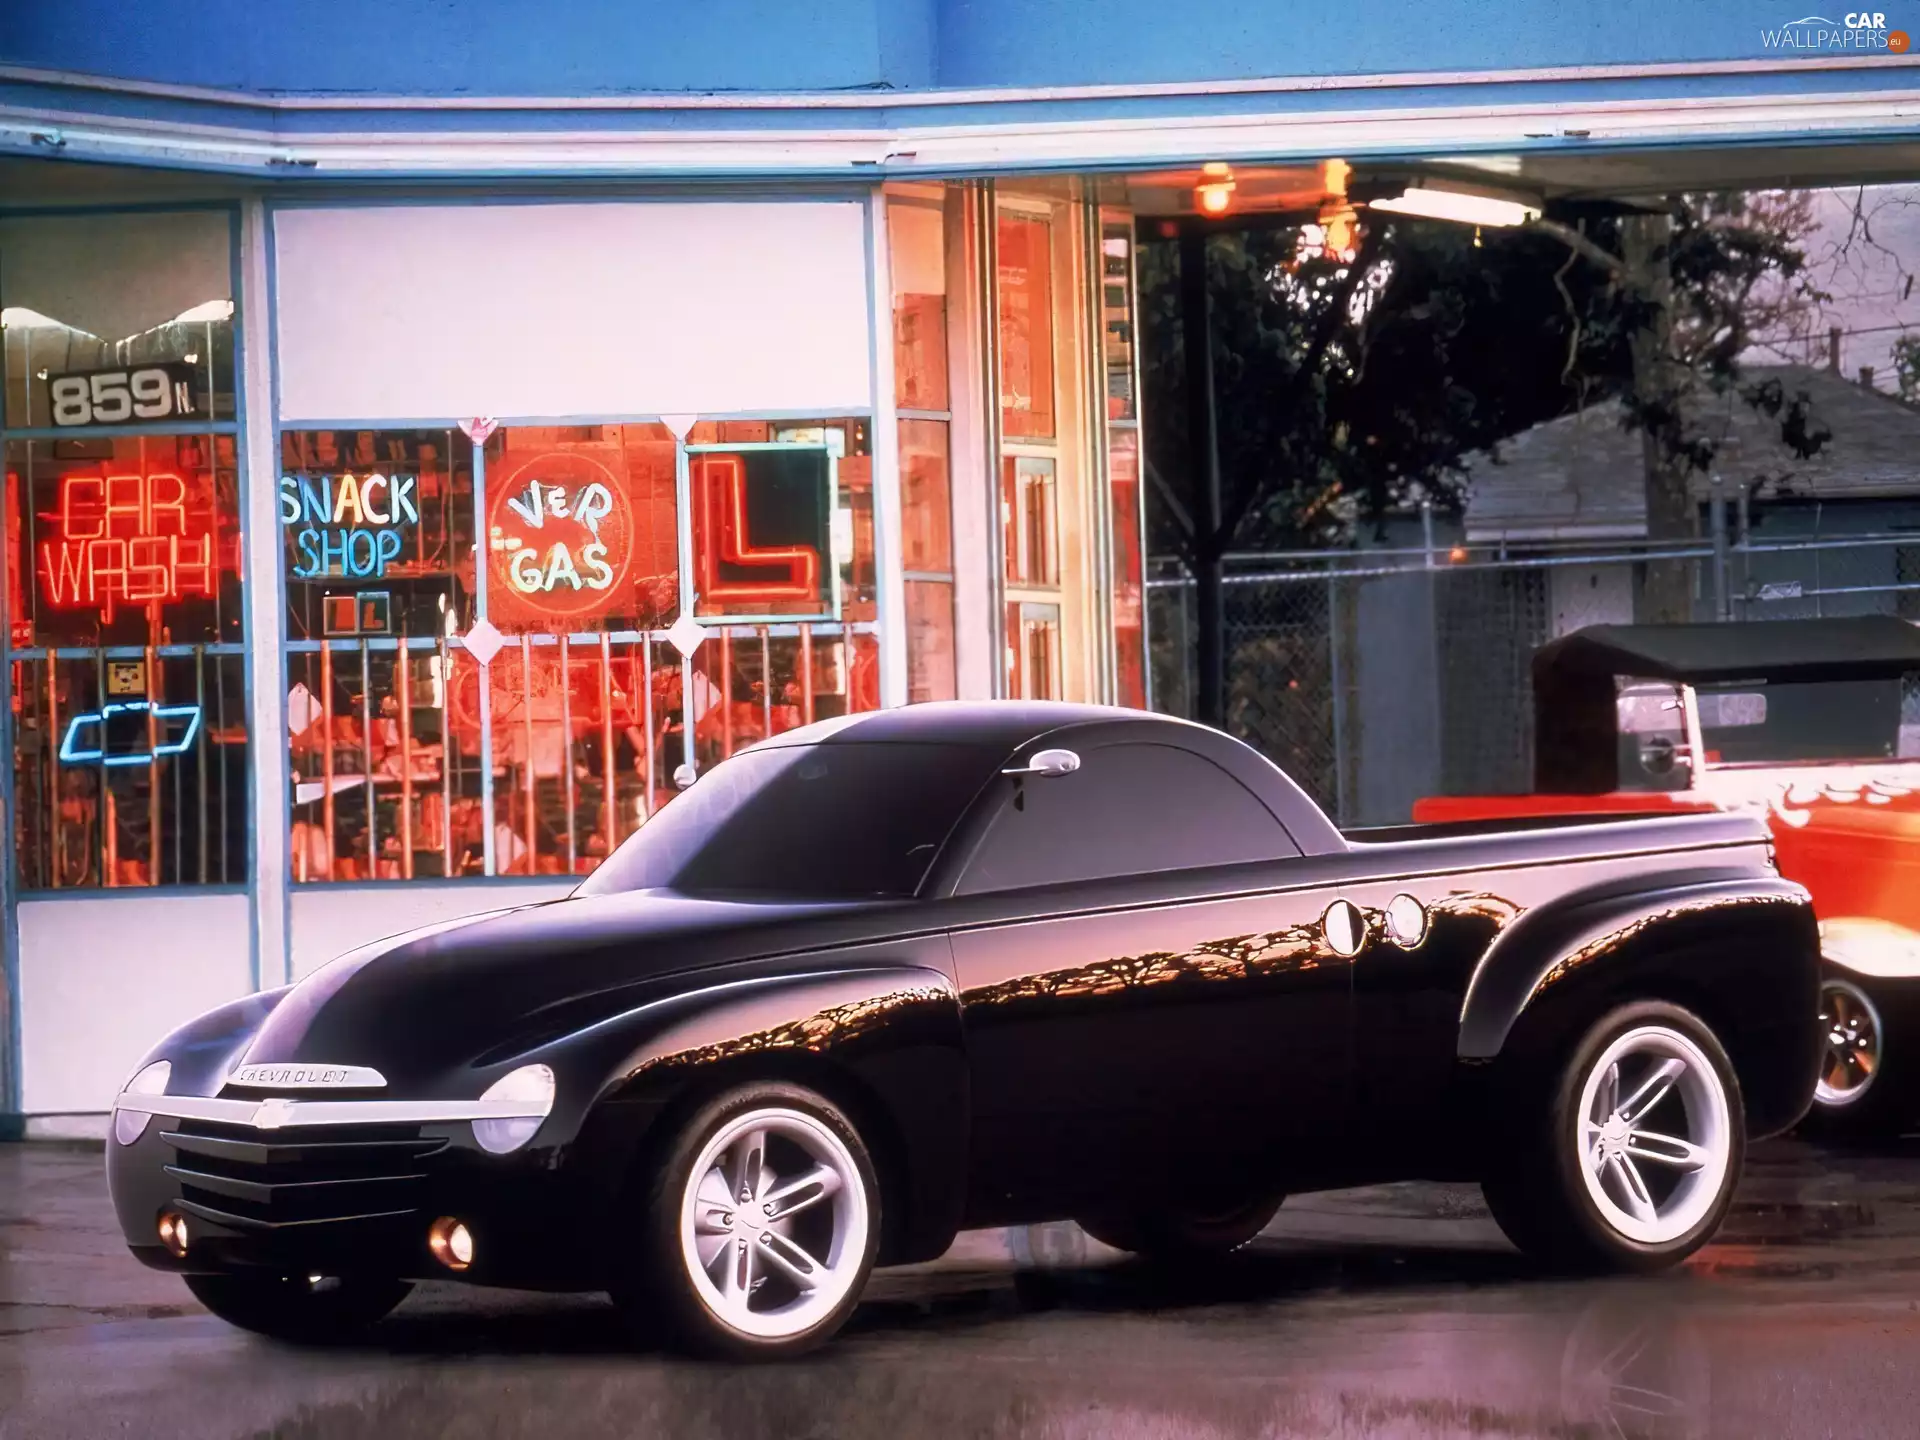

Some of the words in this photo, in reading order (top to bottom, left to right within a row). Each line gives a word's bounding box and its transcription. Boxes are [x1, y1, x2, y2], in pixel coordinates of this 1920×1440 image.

[52, 368, 172, 426] 859
[64, 474, 186, 540] CAR
[280, 473, 418, 524] SNACK
[44, 532, 210, 603] WASH
[293, 529, 401, 577] SHOP
[510, 542, 613, 593] GAS
